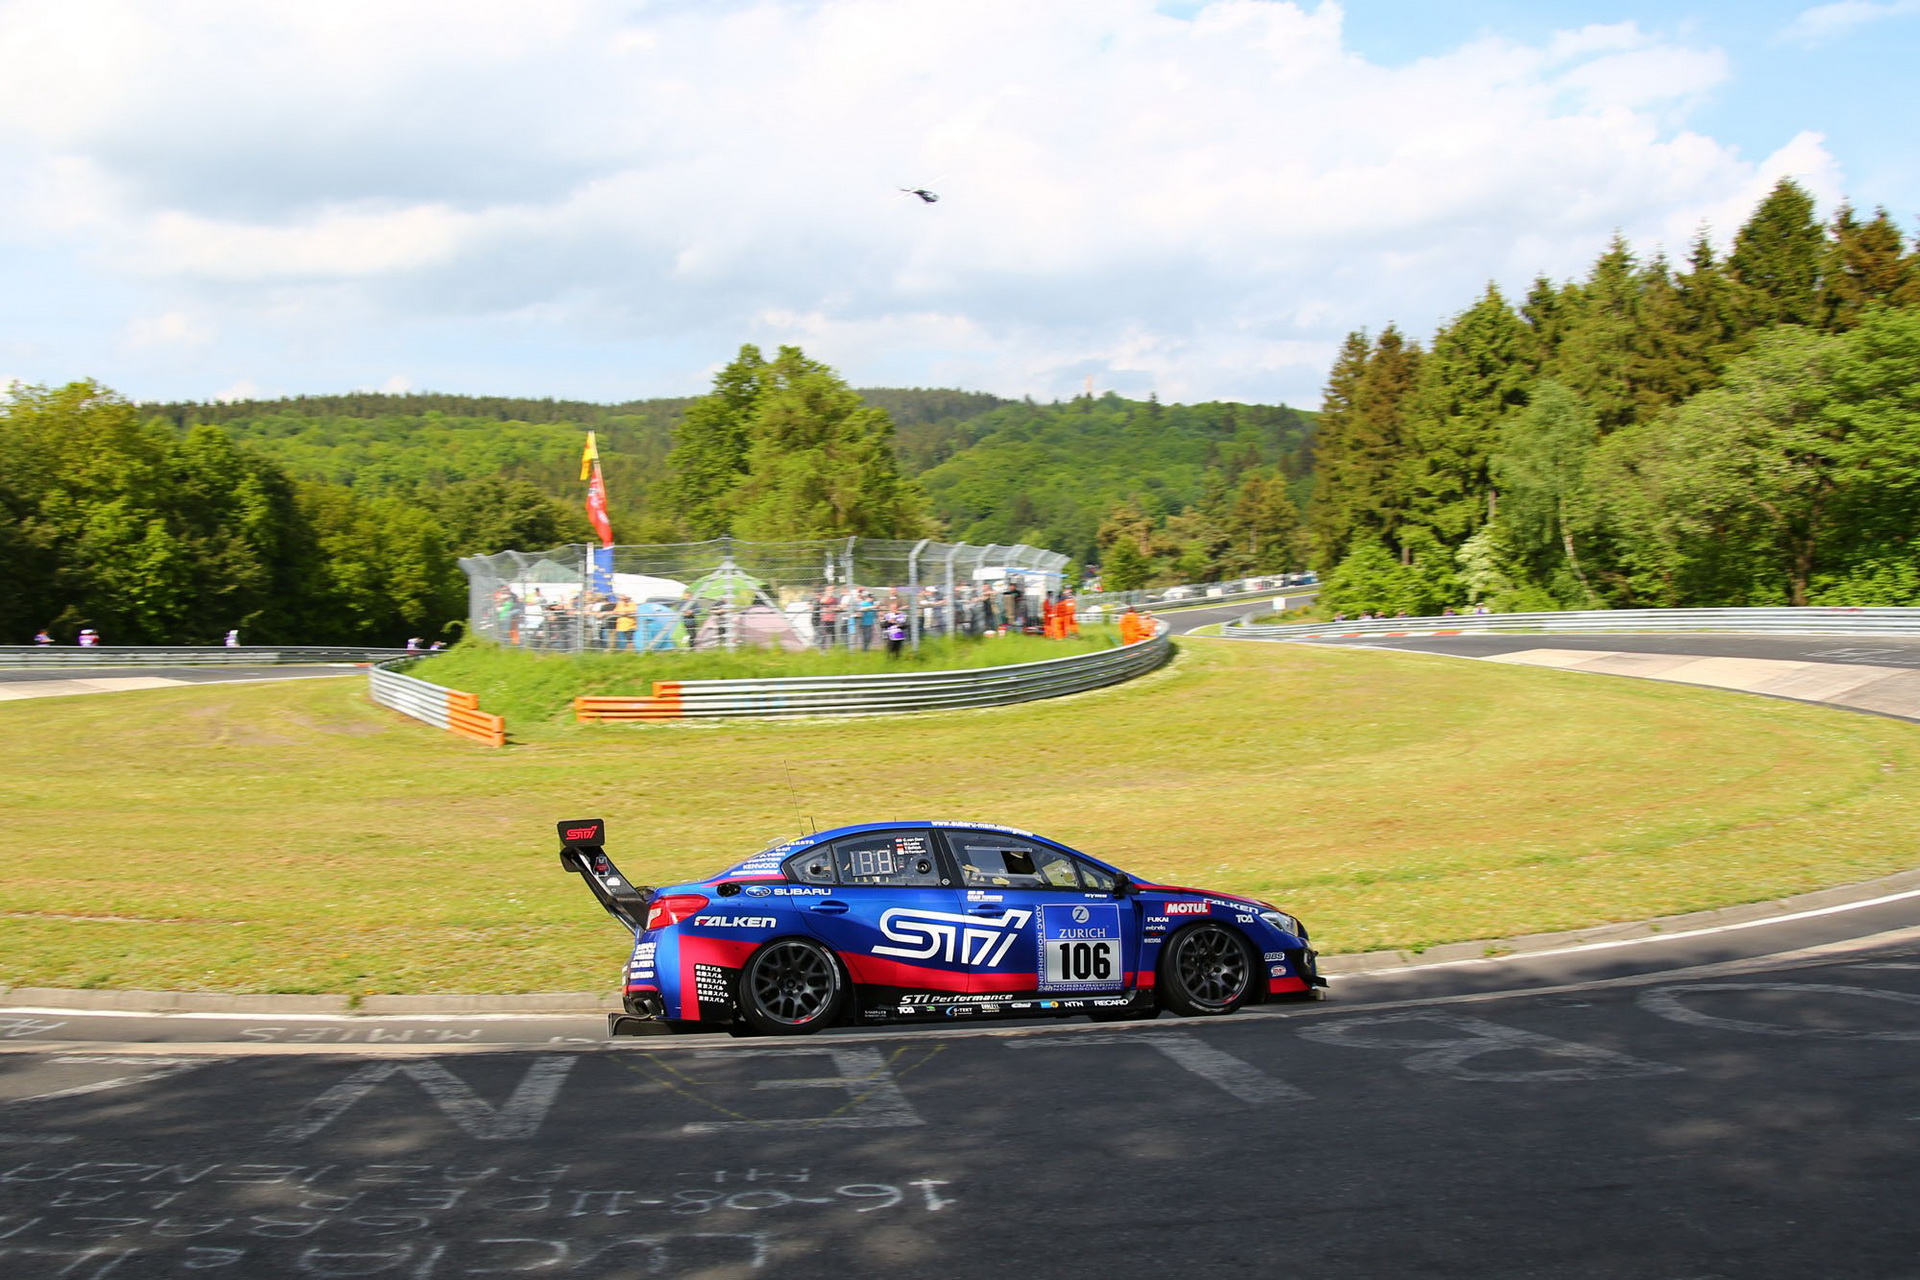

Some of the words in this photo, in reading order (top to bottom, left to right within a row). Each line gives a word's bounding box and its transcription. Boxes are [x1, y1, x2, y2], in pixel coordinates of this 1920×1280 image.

[774, 888, 832, 896] SUBARU
[1167, 904, 1208, 913] MOTUL
[1203, 898, 1259, 915] FALKEN
[694, 915, 777, 928] FALKEN
[1036, 905, 1044, 929] ADAC
[1236, 915, 1254, 923] TOA
[1059, 928, 1106, 939] ZURICH
[1037, 931, 1045, 985] NORDRHEIN
[1060, 943, 1110, 980] 106
[1264, 952, 1285, 961] BBS
[899, 994, 930, 1004] STI
[930, 993, 1013, 1003] Performance
[0, 1212, 432, 1241] GRAZI
